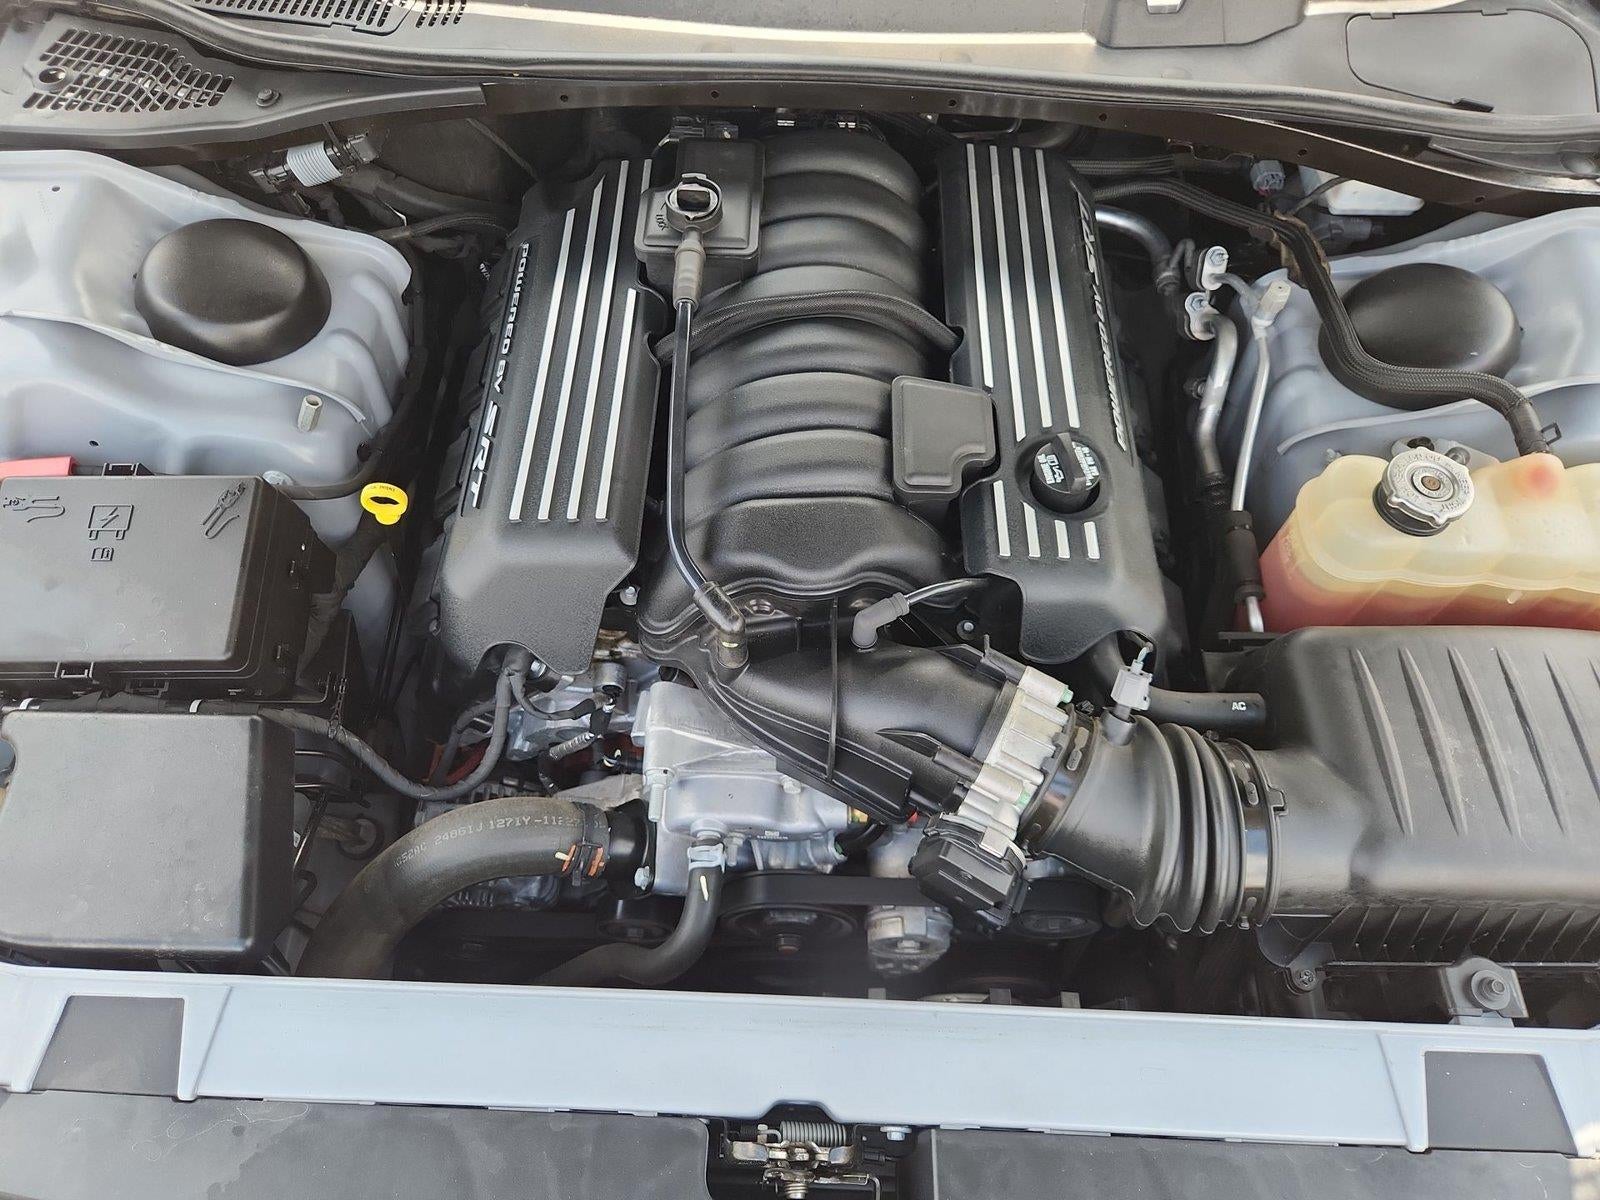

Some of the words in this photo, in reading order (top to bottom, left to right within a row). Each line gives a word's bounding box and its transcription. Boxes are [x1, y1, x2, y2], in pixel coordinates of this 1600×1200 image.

[501, 242, 530, 355] POWERED
[494, 359, 507, 393] BY
[471, 400, 498, 508] SRT
[1231, 701, 1247, 711] AC
